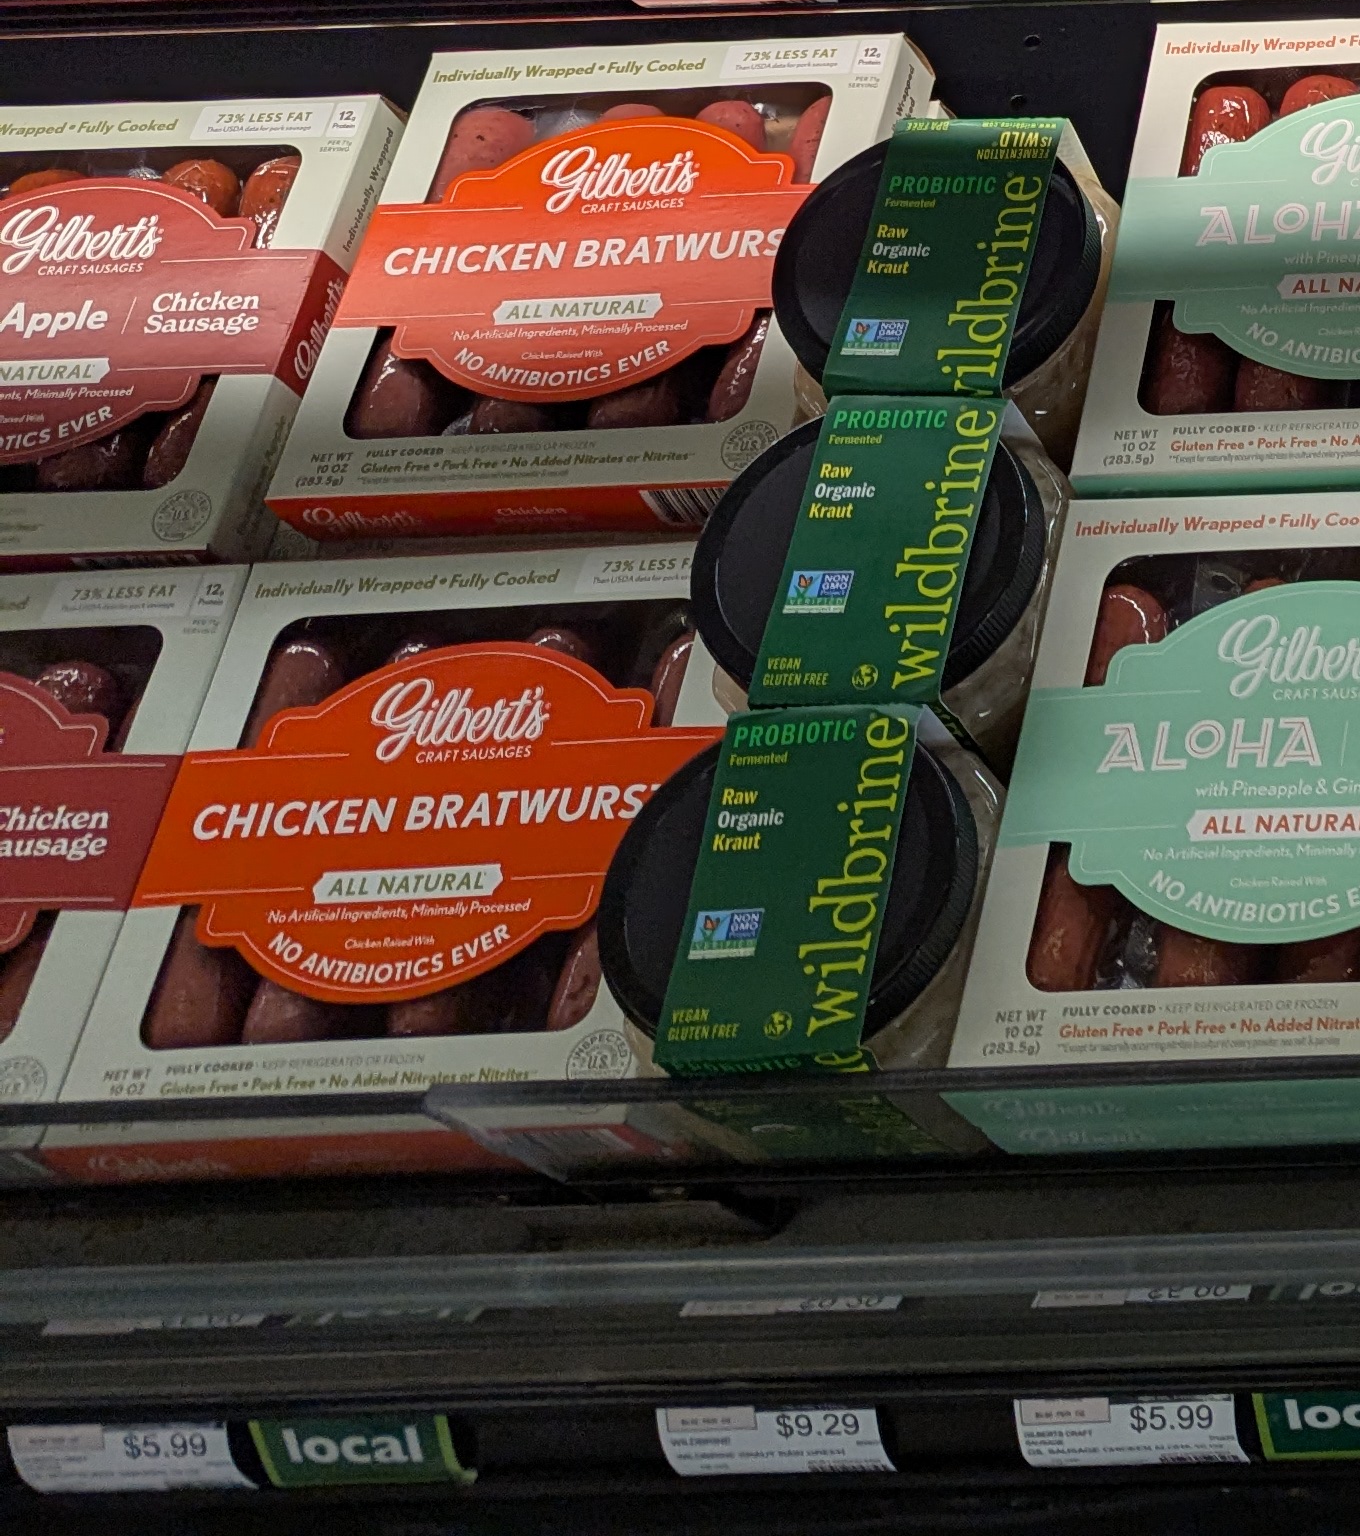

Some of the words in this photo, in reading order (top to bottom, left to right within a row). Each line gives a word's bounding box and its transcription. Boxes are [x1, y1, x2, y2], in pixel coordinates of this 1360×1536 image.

[1165, 40, 1259, 56] Individually
[1263, 36, 1335, 54] Wrapped
[999, 131, 1039, 147] WILD
[541, 145, 699, 215] Gilbert's
[889, 176, 997, 194] PROBIOTIC
[1, 214, 164, 275] Gilbert's
[383, 240, 566, 276] CHICKEN
[575, 228, 784, 269] BRATWURS
[506, 300, 542, 319] ALL
[832, 409, 948, 430] PROBIOTIC
[1114, 430, 1136, 441] NET
[1140, 430, 1158, 441] WT
[820, 464, 852, 478] Raw
[814, 482, 875, 501] Organic
[808, 503, 854, 518] Kraut
[884, 407, 998, 689] wildbrine
[767, 658, 801, 670] VEGAN
[762, 673, 797, 686] GLUTEN
[801, 673, 828, 685] FREE
[371, 678, 550, 764] Gilbert's
[734, 719, 857, 748] PROBIOTIC
[1097, 717, 1322, 773] ALOHA
[192, 792, 395, 841] CHICKEN
[799, 716, 909, 1038] wildbrine
[776, 1413, 859, 1440] $9.29
[1129, 1405, 1214, 1434] $5.99
[123, 1432, 207, 1459] $5.99
[282, 1425, 424, 1464] local
